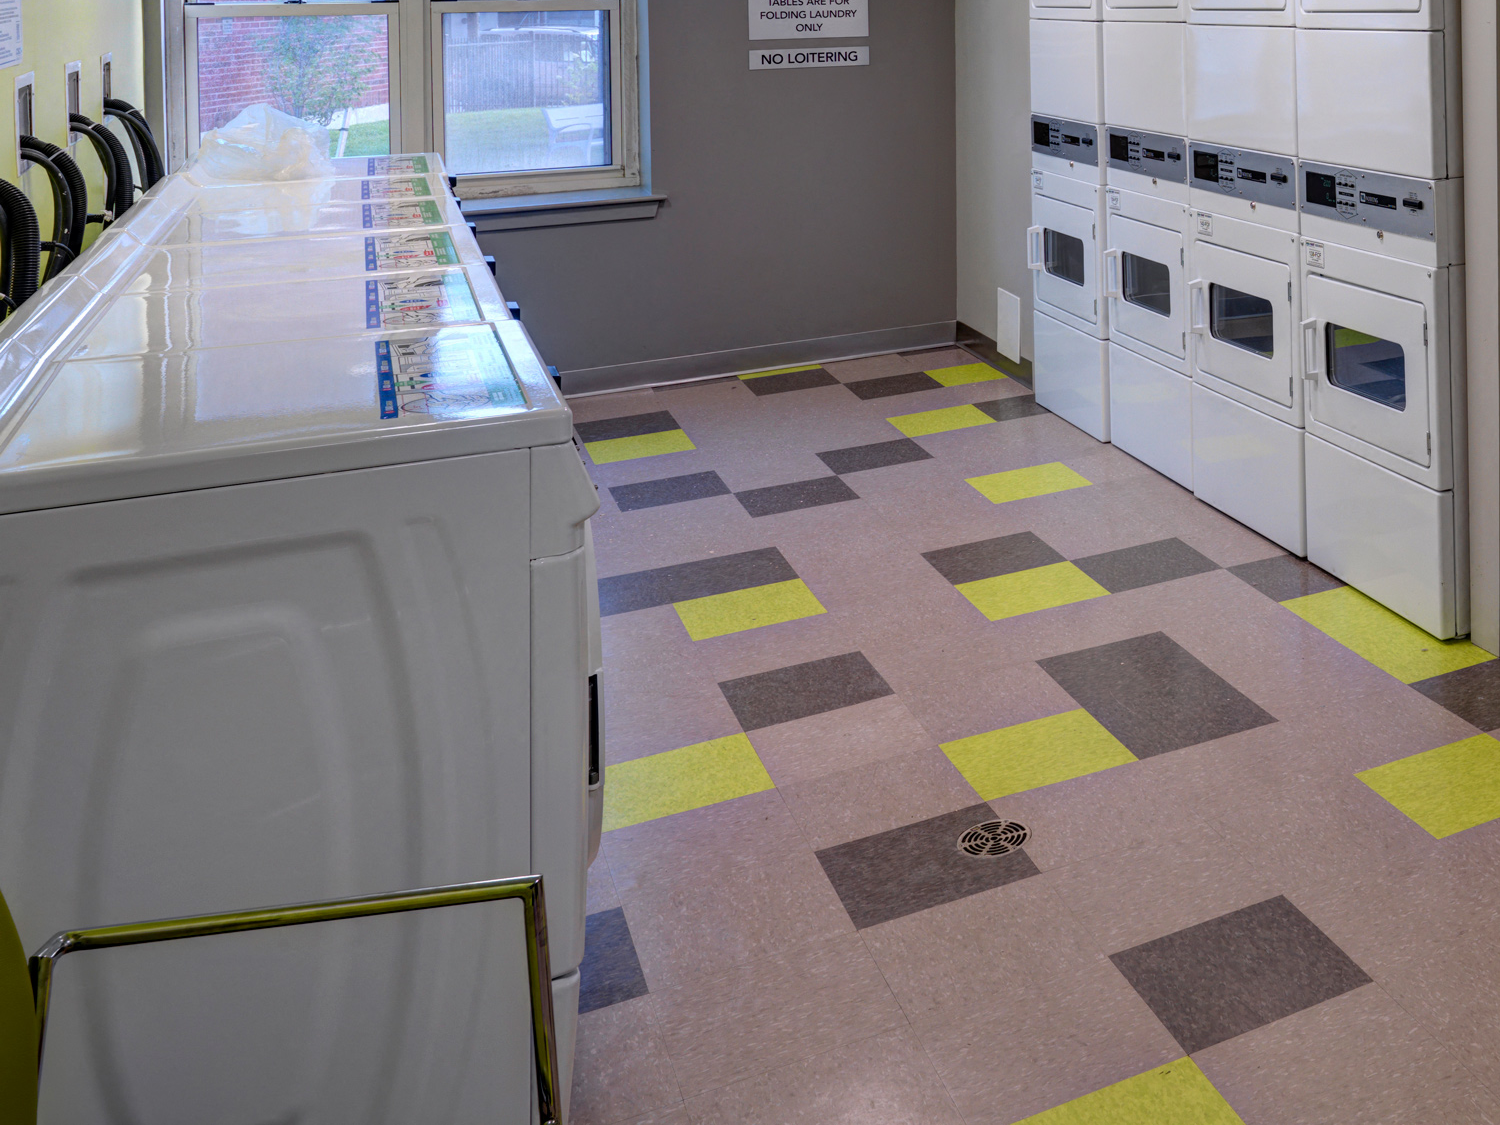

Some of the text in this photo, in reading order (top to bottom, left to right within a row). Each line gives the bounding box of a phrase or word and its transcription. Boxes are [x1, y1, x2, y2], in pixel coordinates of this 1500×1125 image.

[760, 10, 857, 19] FOLDING LAUNDRY
[796, 23, 823, 32] ONLY
[762, 51, 858, 65] NO LOITERING
